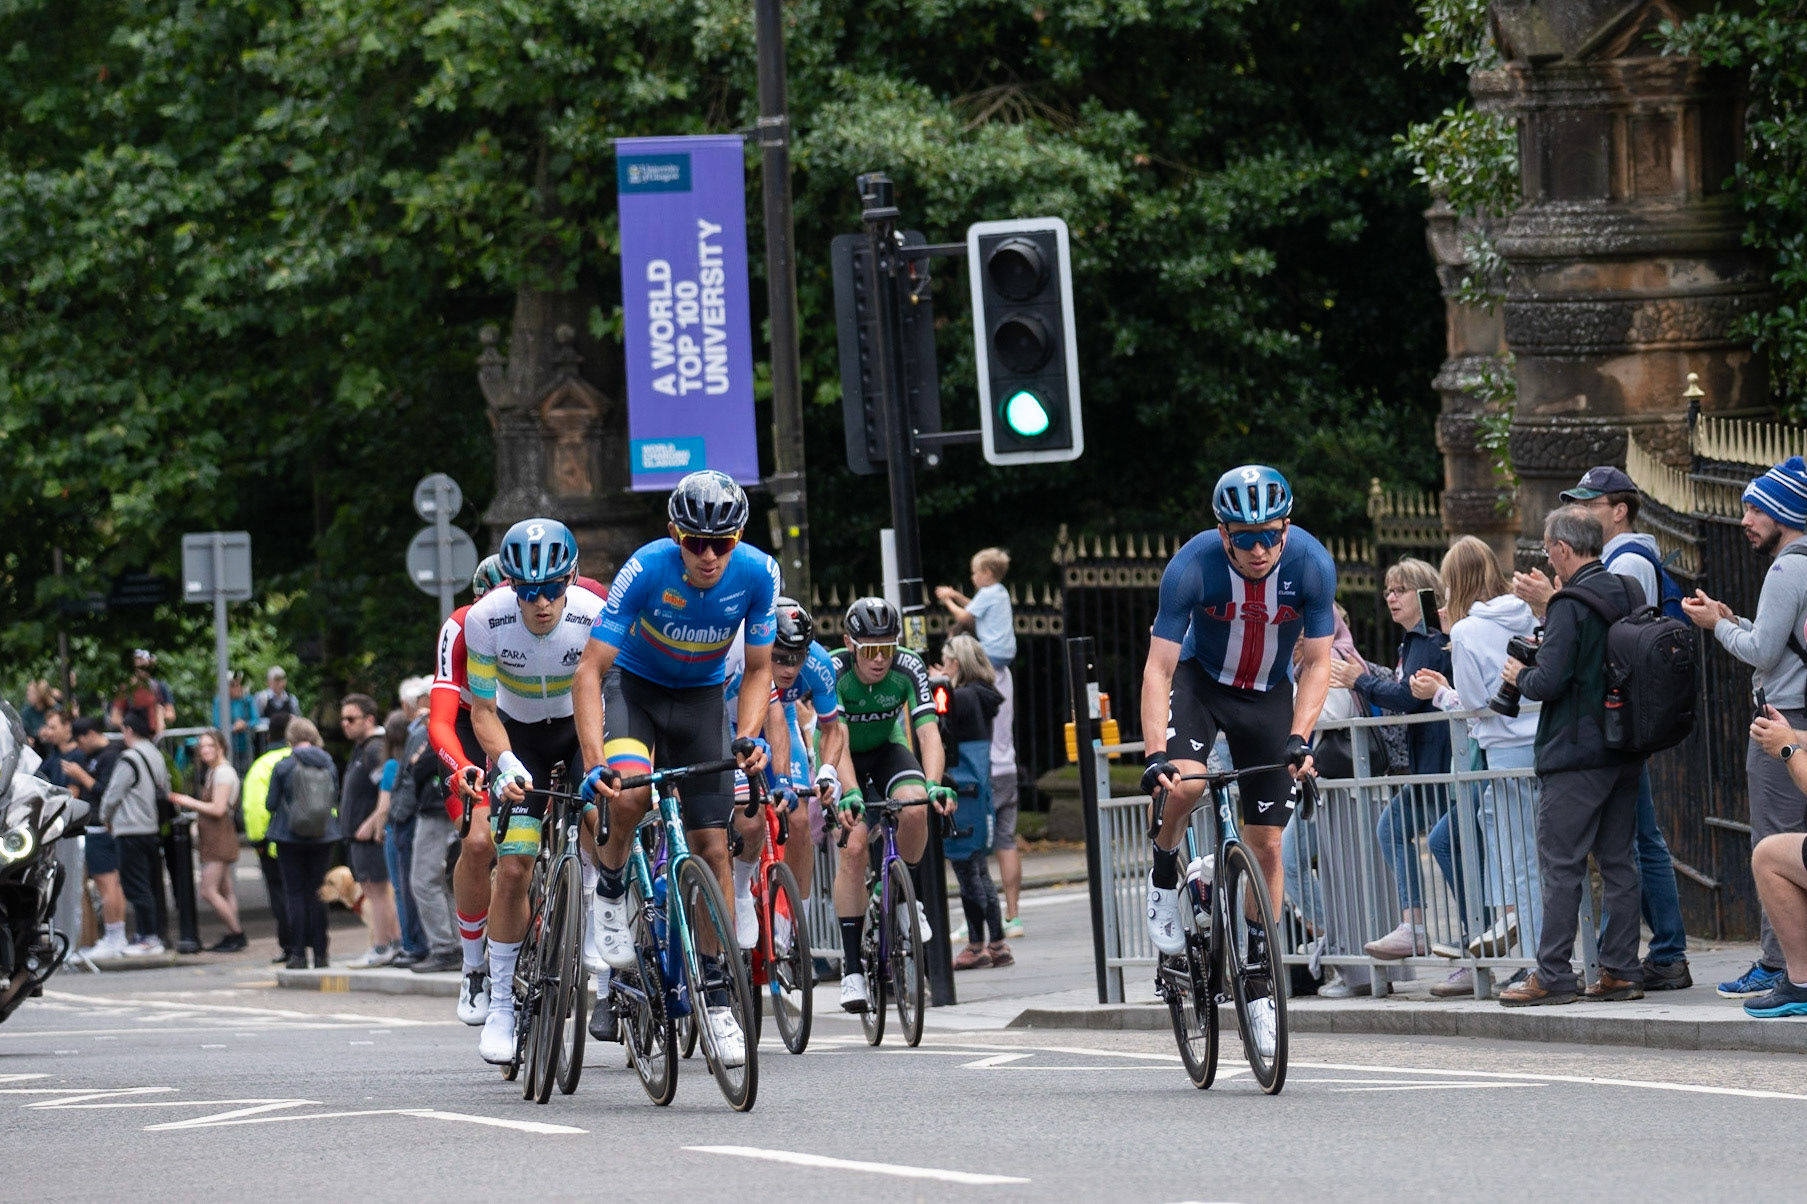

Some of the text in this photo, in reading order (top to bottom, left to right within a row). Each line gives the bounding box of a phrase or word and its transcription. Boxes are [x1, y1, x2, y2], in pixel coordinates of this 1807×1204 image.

[698, 218, 730, 395] UNIVERSITY
[647, 259, 677, 396] A WORLD
[674, 280, 703, 396] TOP 100
[488, 612, 517, 629] Santini
[565, 612, 594, 627] Santini
[1204, 600, 1300, 625] USA
[662, 621, 731, 643] Colombia
[897, 653, 931, 703] IRELAND
